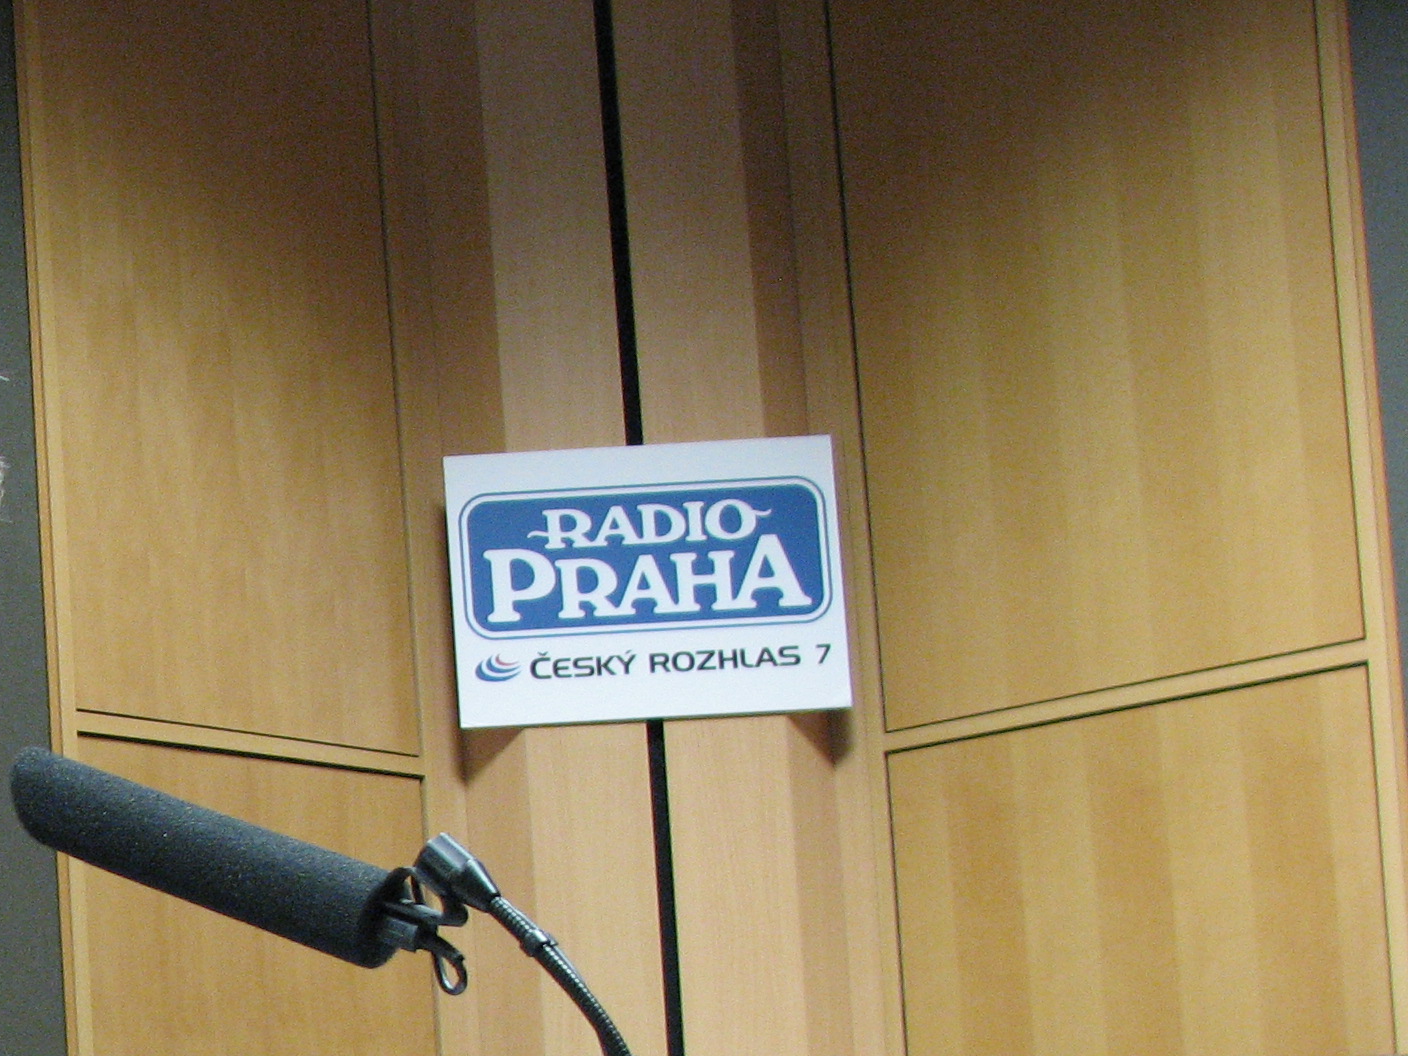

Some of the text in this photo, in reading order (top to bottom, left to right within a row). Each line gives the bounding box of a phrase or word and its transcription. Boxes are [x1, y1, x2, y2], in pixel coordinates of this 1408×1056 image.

[528, 498, 772, 550] RADIO
[483, 534, 813, 624] PRAHA
[530, 643, 832, 680] ČESKÝ ROZHLAS 7
